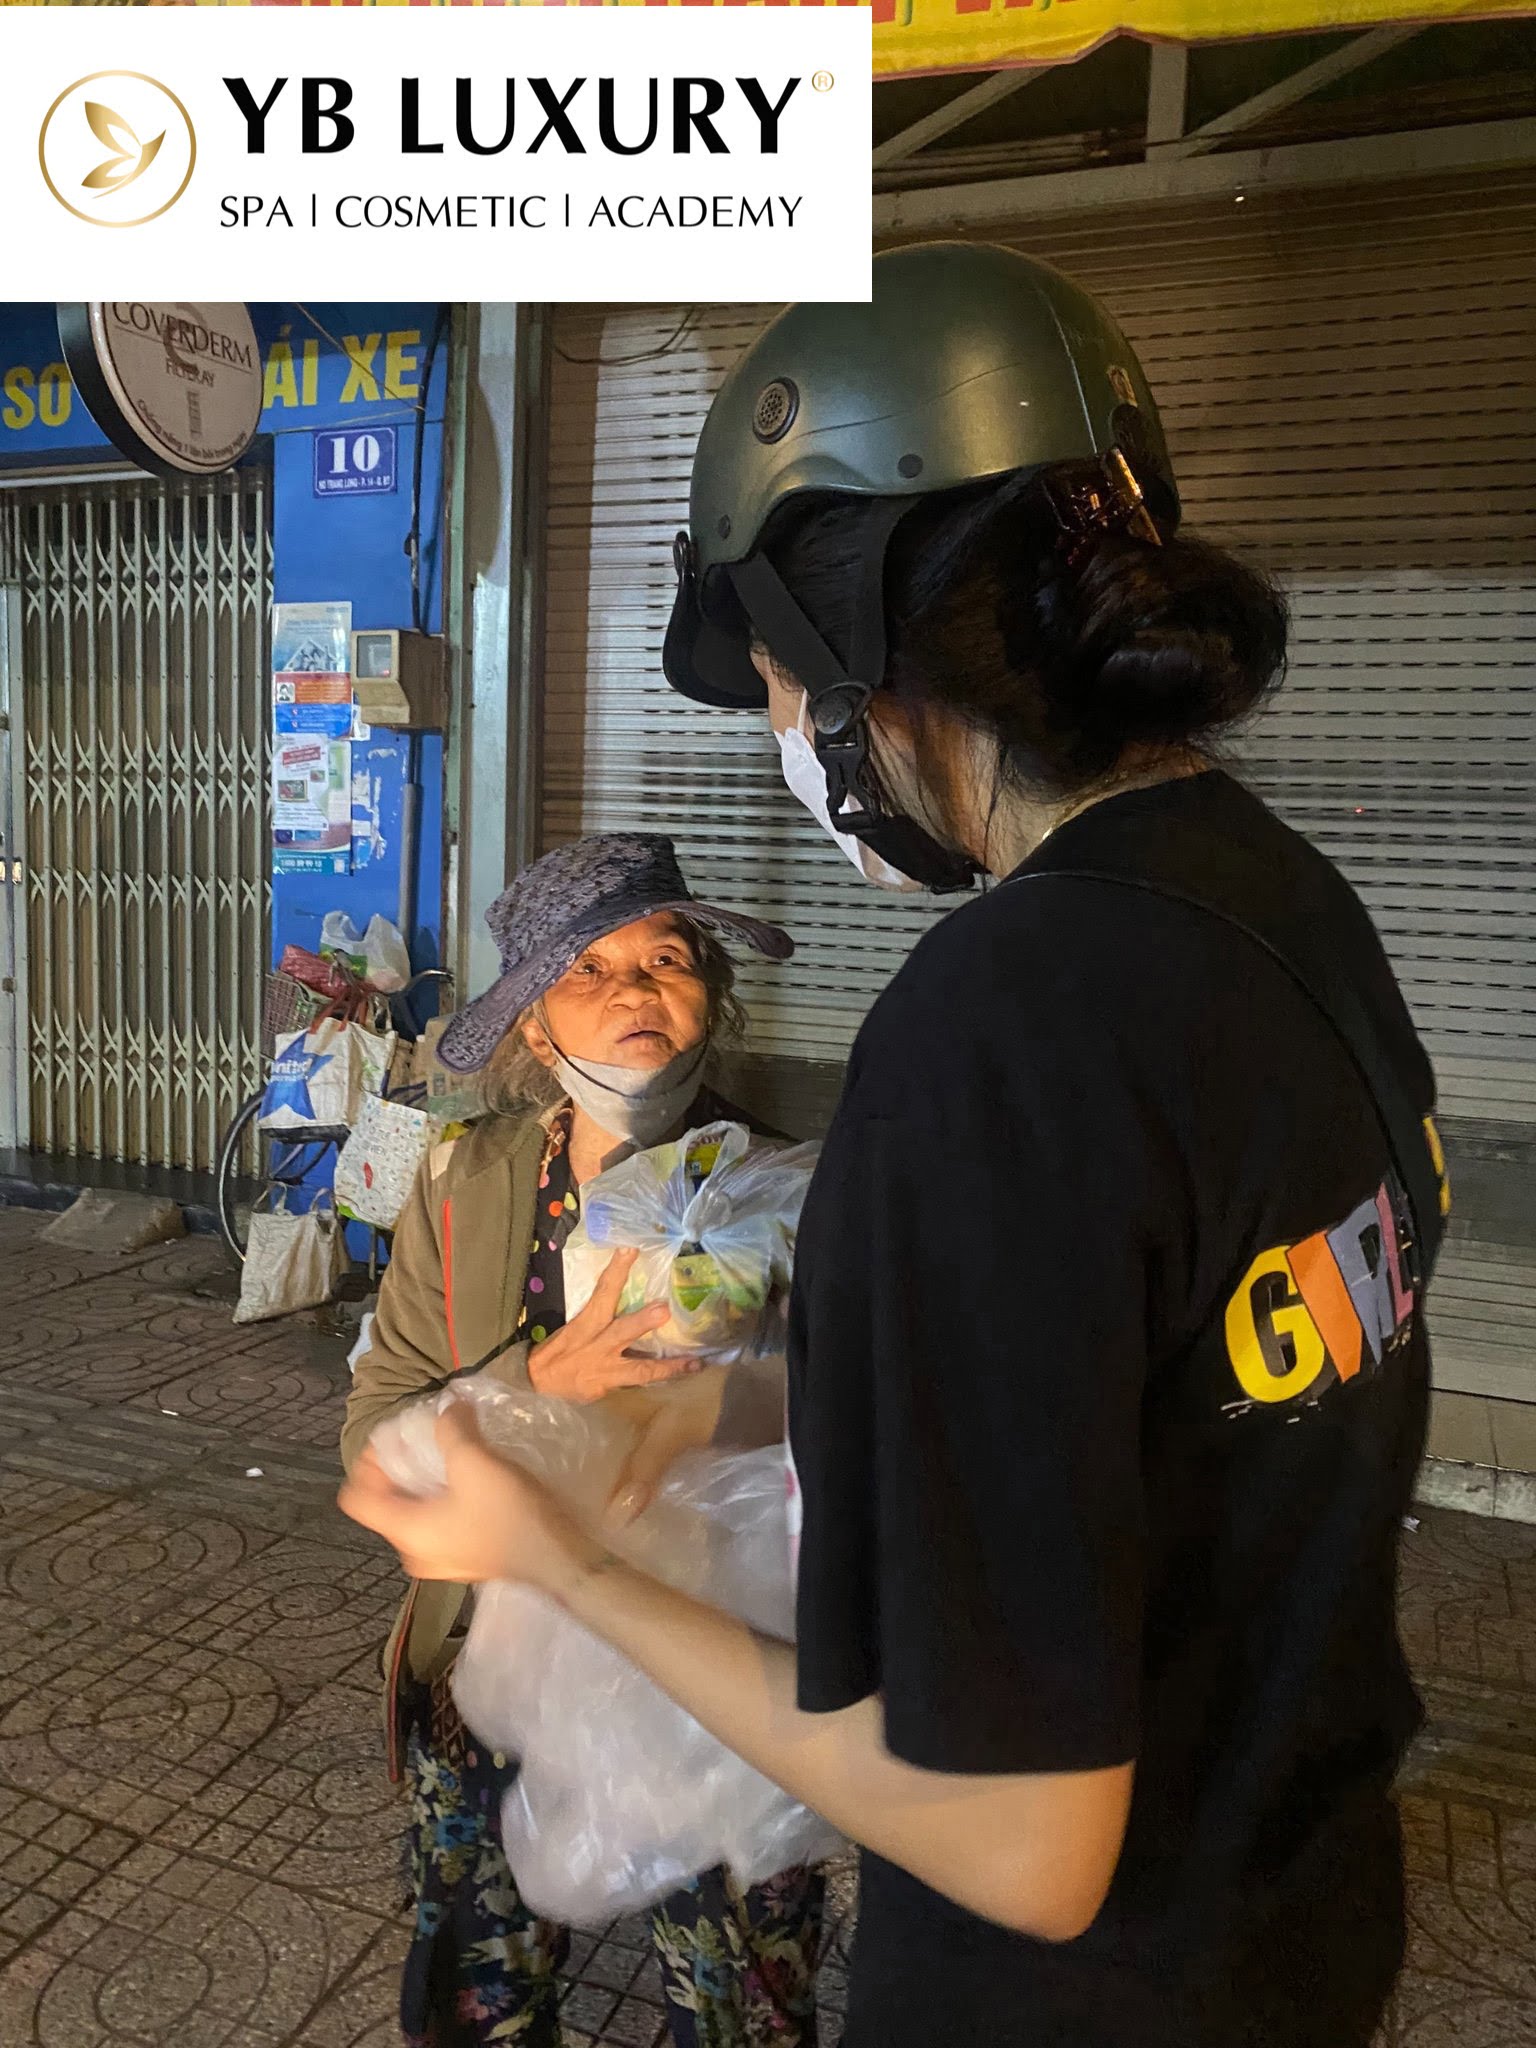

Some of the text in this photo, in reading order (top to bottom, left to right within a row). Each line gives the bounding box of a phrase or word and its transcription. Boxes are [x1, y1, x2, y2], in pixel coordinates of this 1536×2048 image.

[112, 302, 252, 368] COVERDERM
[262, 324, 318, 410] ÁI
[339, 330, 421, 404] XE
[328, 434, 380, 474] 10
[1225, 1182, 1413, 1403] GIRL
